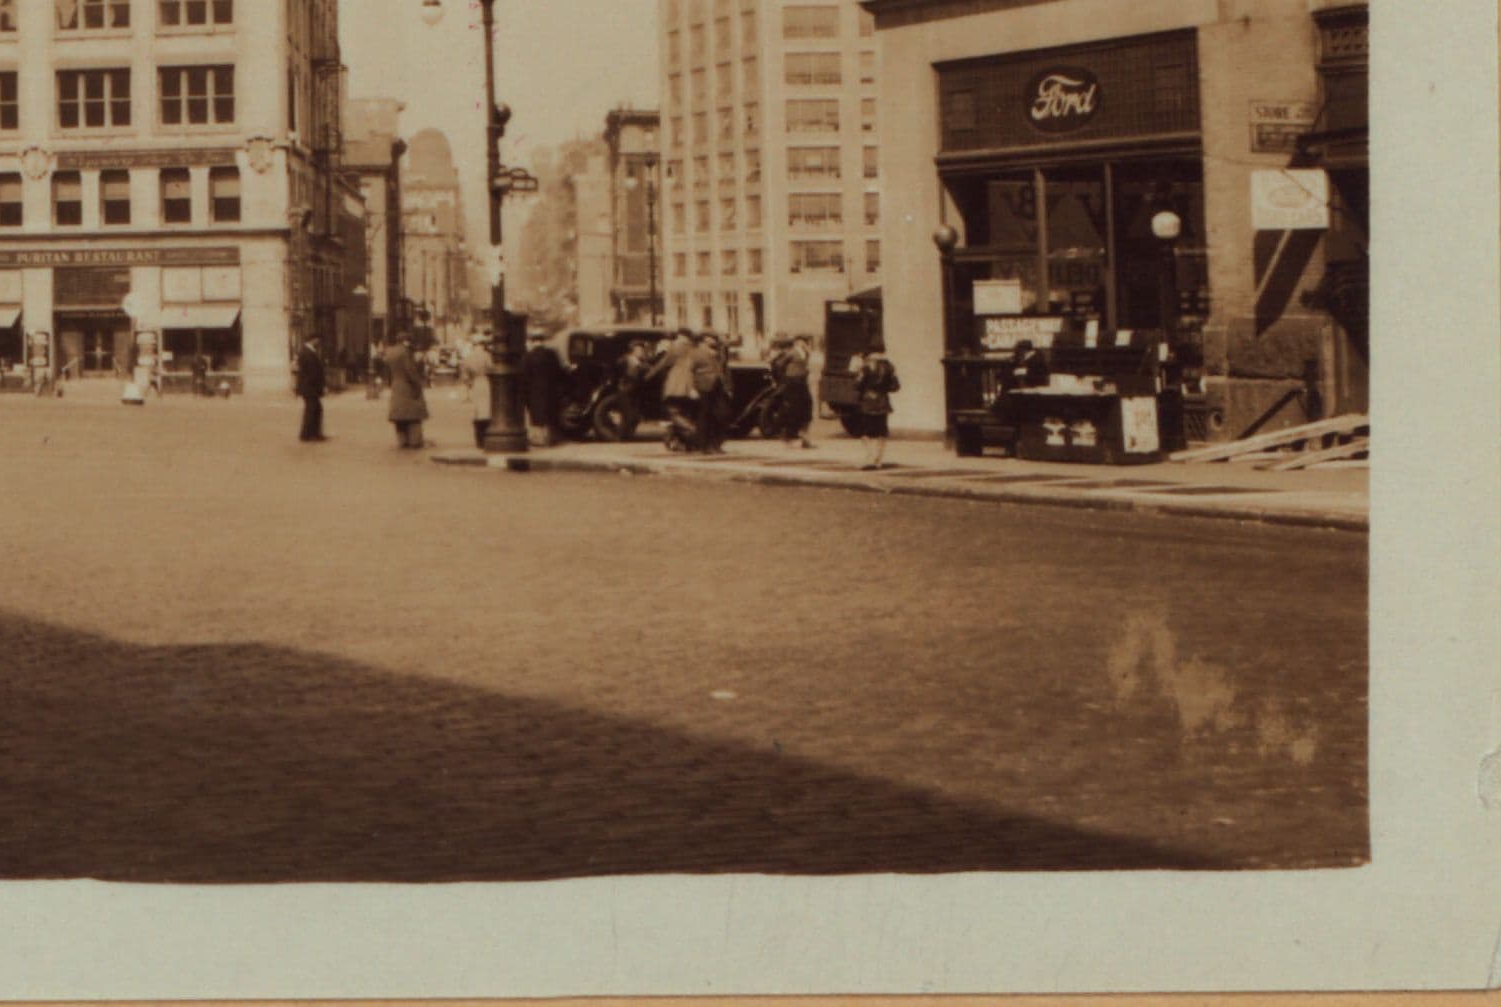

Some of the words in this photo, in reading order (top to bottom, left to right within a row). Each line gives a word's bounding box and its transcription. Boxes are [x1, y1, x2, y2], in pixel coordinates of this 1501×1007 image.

[1031, 74, 1096, 120] Ford
[15, 251, 70, 264] PURITAN
[74, 250, 161, 264] RESTAURANT
